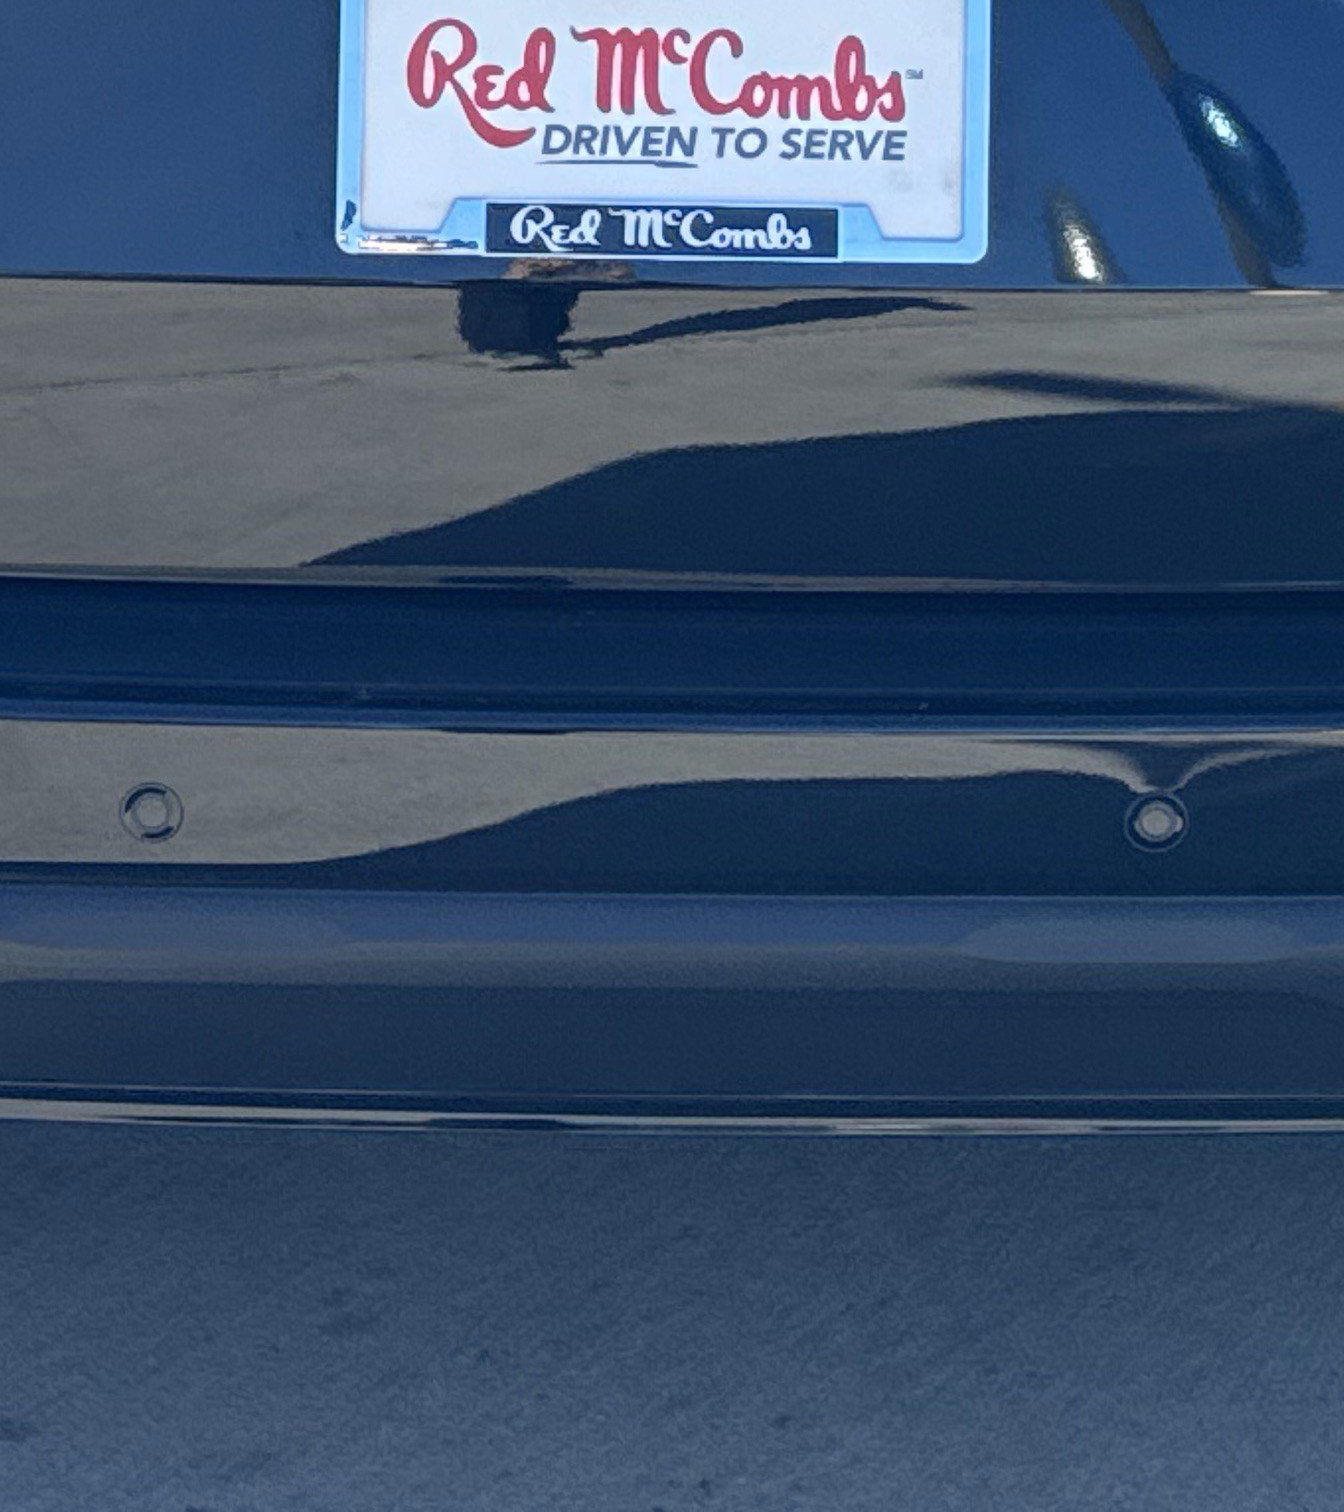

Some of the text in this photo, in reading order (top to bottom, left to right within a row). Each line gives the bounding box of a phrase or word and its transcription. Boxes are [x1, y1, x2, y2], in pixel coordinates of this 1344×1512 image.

[406, 18, 556, 149] Red
[570, 26, 906, 122] McCombs
[541, 123, 908, 162] DRIVEN TO SERVE
[509, 204, 813, 251] Red McCombs
